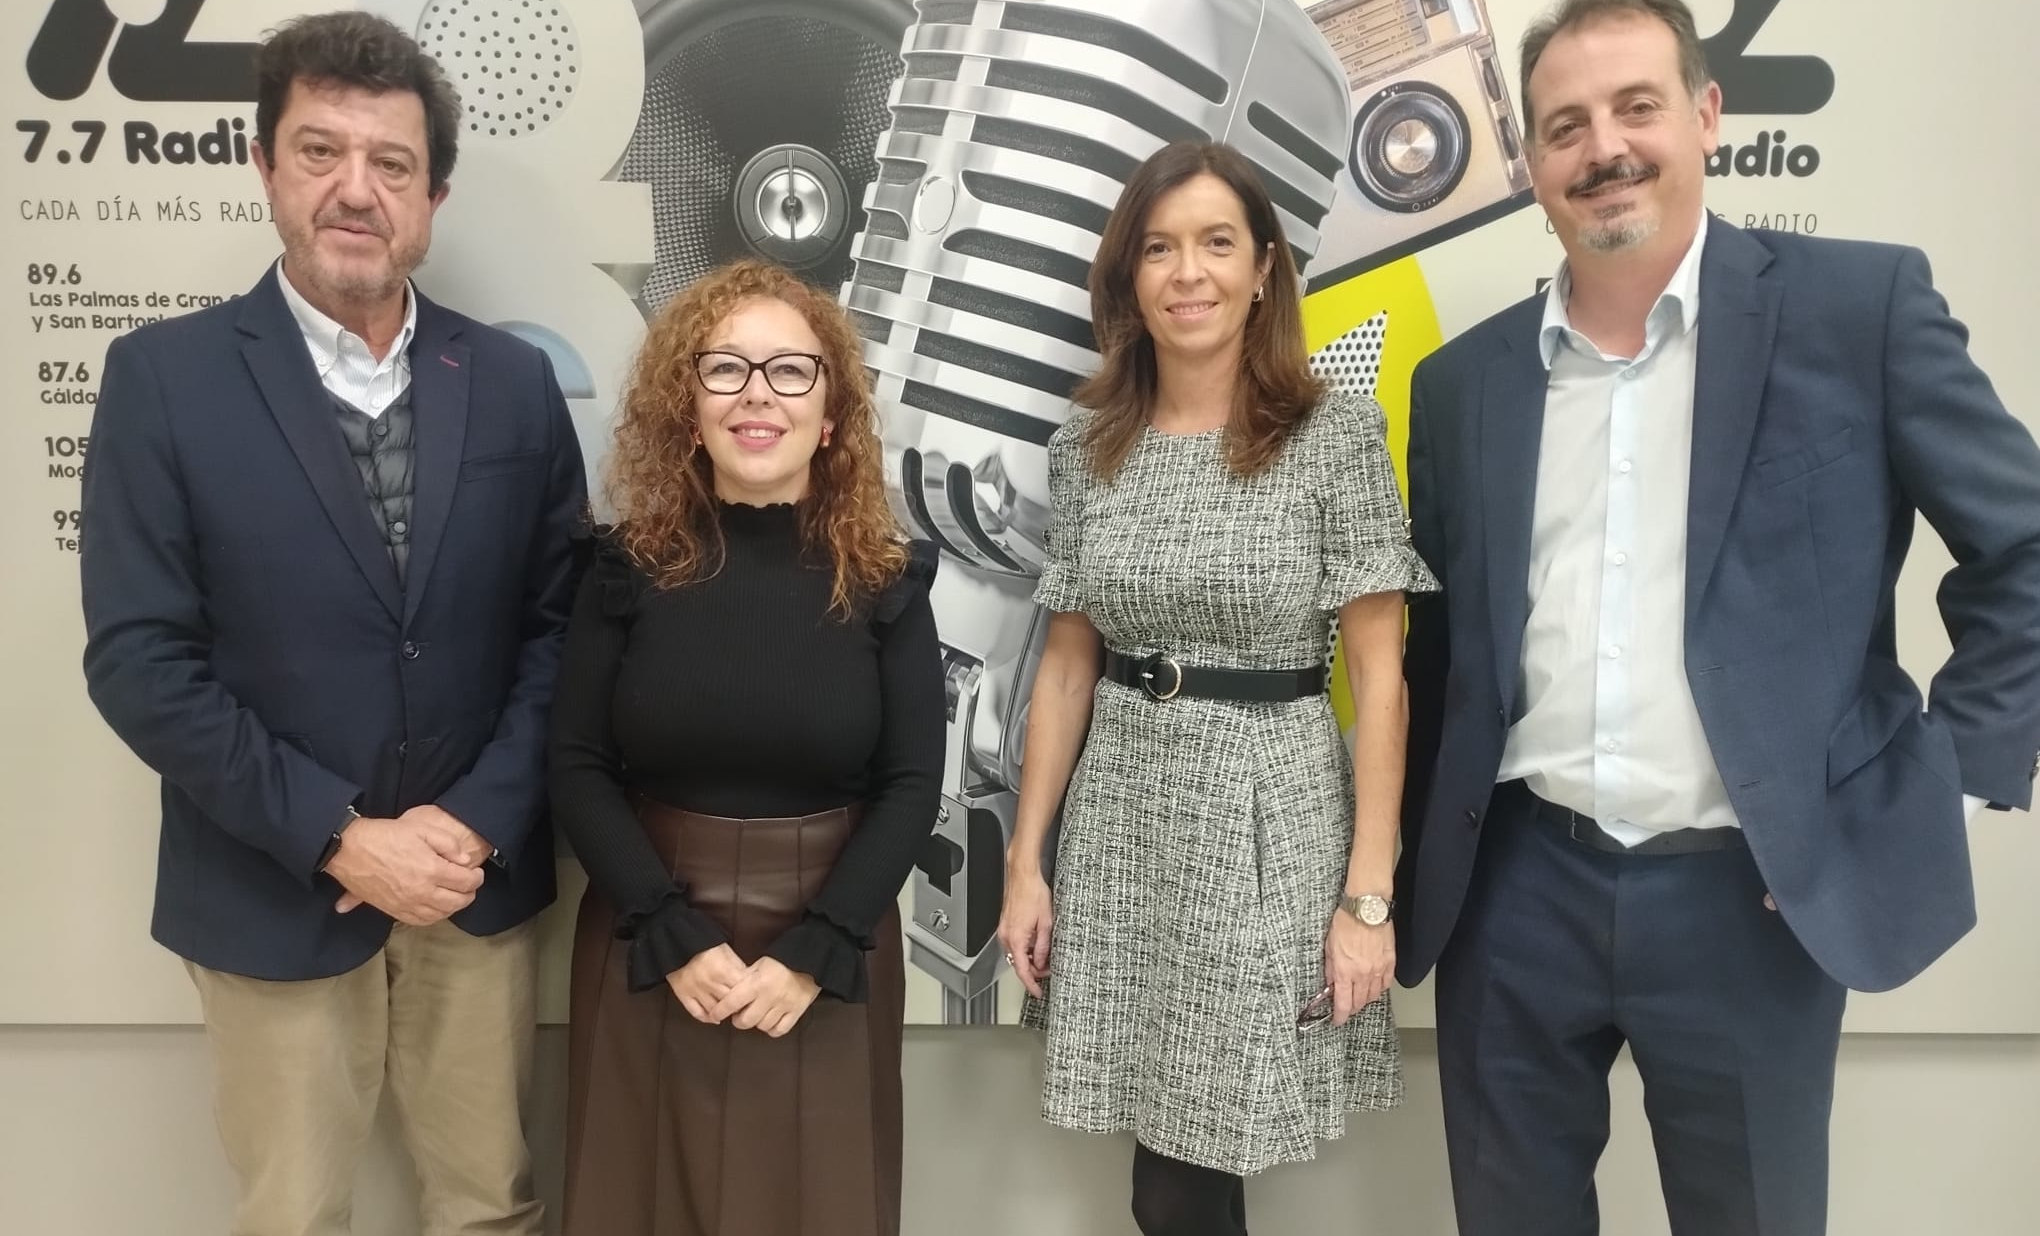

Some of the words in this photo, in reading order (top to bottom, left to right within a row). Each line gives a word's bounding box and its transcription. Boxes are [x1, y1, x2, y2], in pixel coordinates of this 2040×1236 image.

[16, 119, 107, 164] 7.7
[124, 117, 249, 165] Radi
[1704, 129, 1820, 178] adio
[20, 199, 80, 221] CADA
[97, 195, 142, 221] DÍA
[157, 195, 202, 222] MÁS
[220, 201, 275, 222] RADI
[1744, 213, 1818, 234] RADIO
[27, 263, 82, 285] 89.6
[29, 292, 63, 307] Las
[68, 291, 140, 307] Palmas
[145, 292, 170, 308] de
[176, 294, 224, 309] Gran
[32, 316, 44, 332] y
[49, 314, 87, 329] San
[92, 314, 164, 329] Barto
[38, 361, 90, 383] 87.6
[40, 388, 98, 405] Gálda
[45, 436, 90, 458] 105
[48, 464, 86, 481] Mog
[53, 510, 82, 530] 99
[55, 535, 81, 554] Tej
